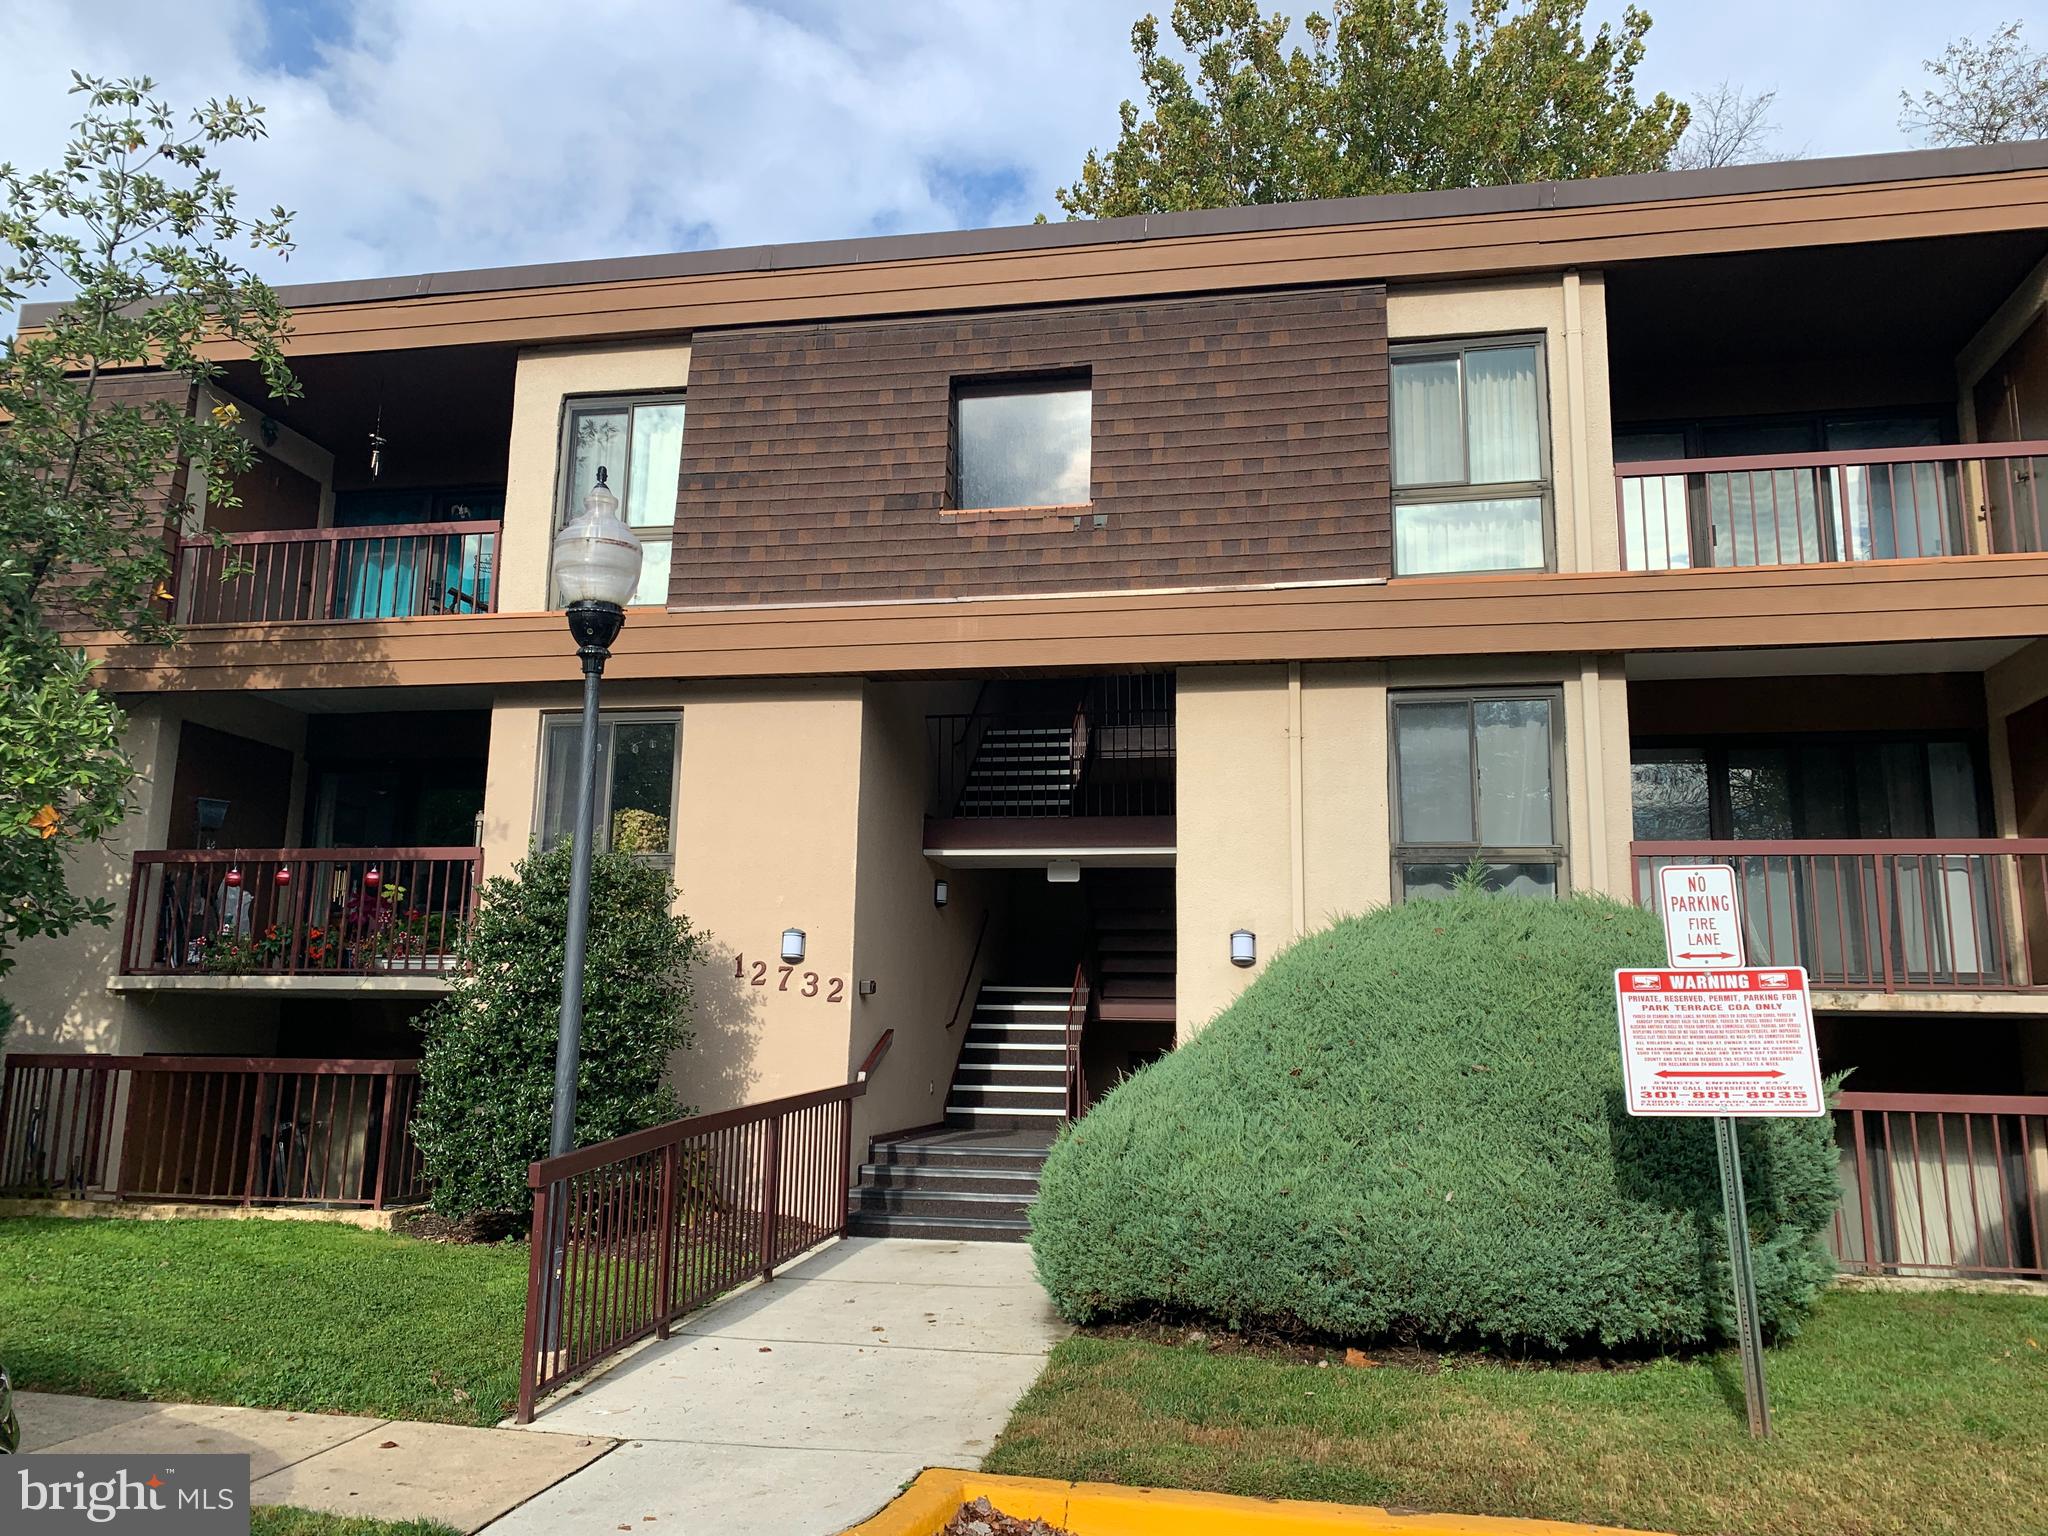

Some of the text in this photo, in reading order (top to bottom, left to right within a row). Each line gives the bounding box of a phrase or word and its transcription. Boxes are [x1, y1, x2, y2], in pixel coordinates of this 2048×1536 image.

[1688, 876, 1706, 892] NO
[1671, 895, 1729, 912] PARKING
[1688, 918, 1717, 930] FIRE
[1688, 933, 1721, 946] LANE
[734, 952, 844, 1003] 12732
[1669, 974, 1750, 989] WARNING
[1628, 993, 1797, 1003] PRIVATE, RESERVED, PERMIT, PARKING FOR
[1675, 1003, 1723, 1011] TERRACE
